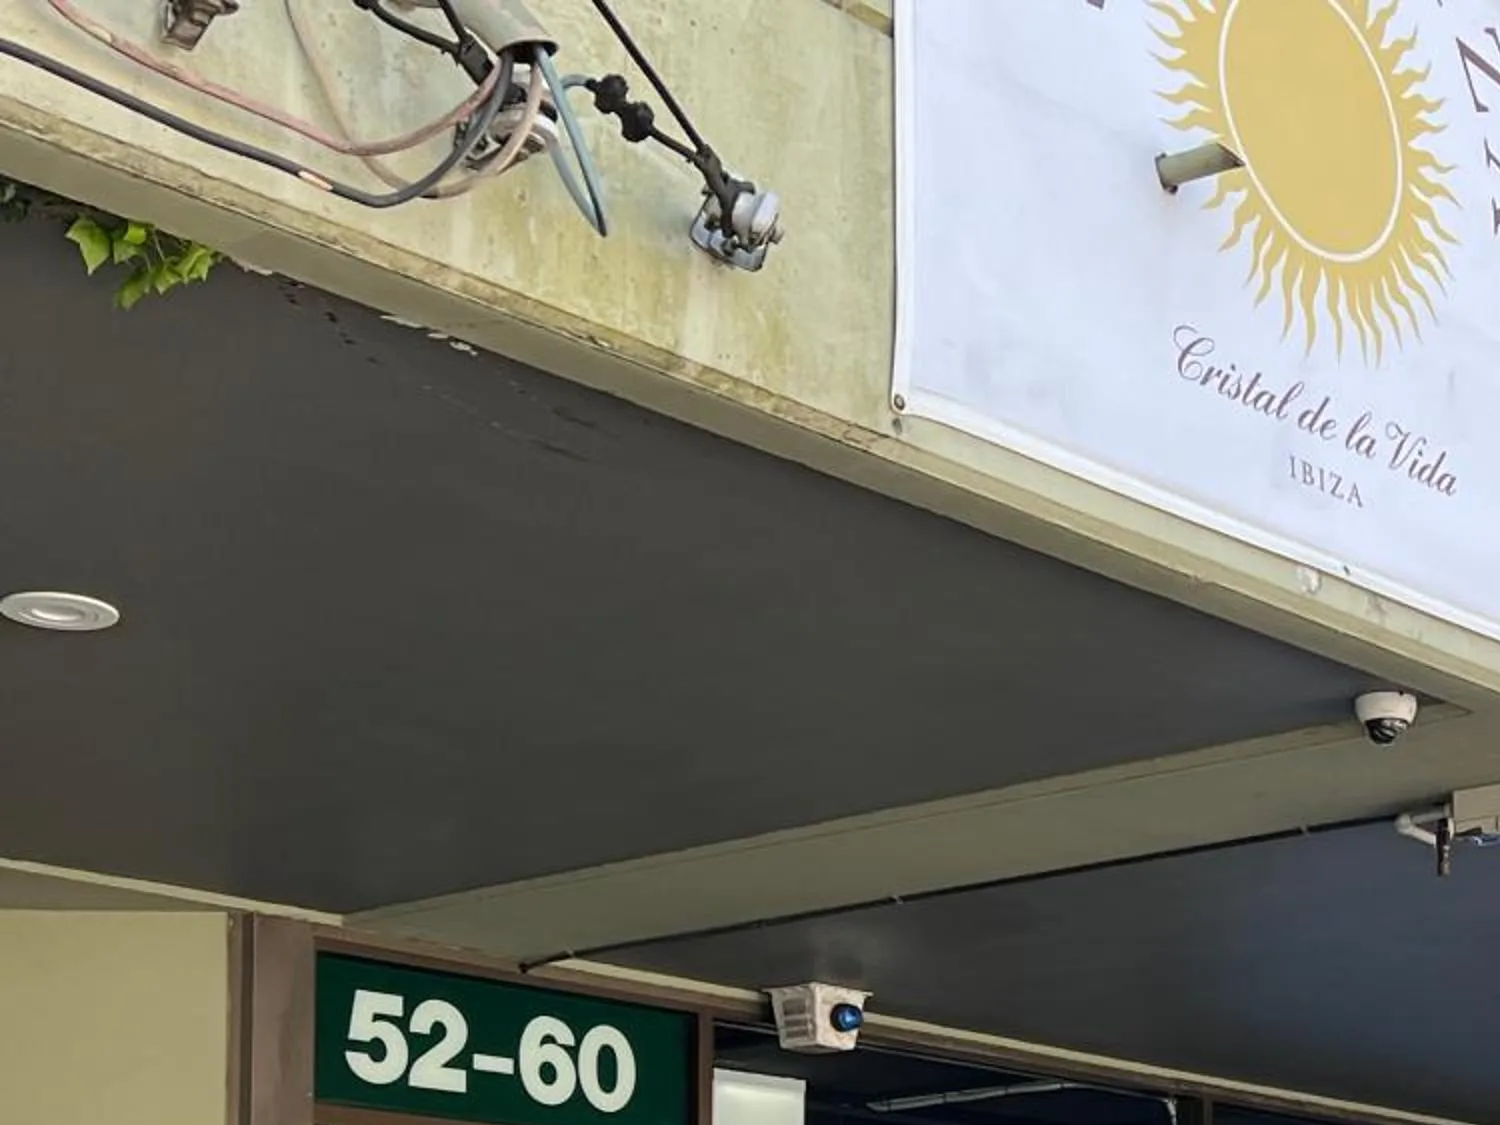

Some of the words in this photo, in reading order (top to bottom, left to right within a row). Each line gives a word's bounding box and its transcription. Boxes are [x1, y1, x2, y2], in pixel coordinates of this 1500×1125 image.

[1173, 324, 1305, 420] Cristal
[1297, 397, 1337, 441] de
[1345, 412, 1377, 459] la
[1385, 421, 1457, 497] Vida
[1289, 455, 1363, 508] IBIZA
[345, 989, 636, 1113] 52-60
